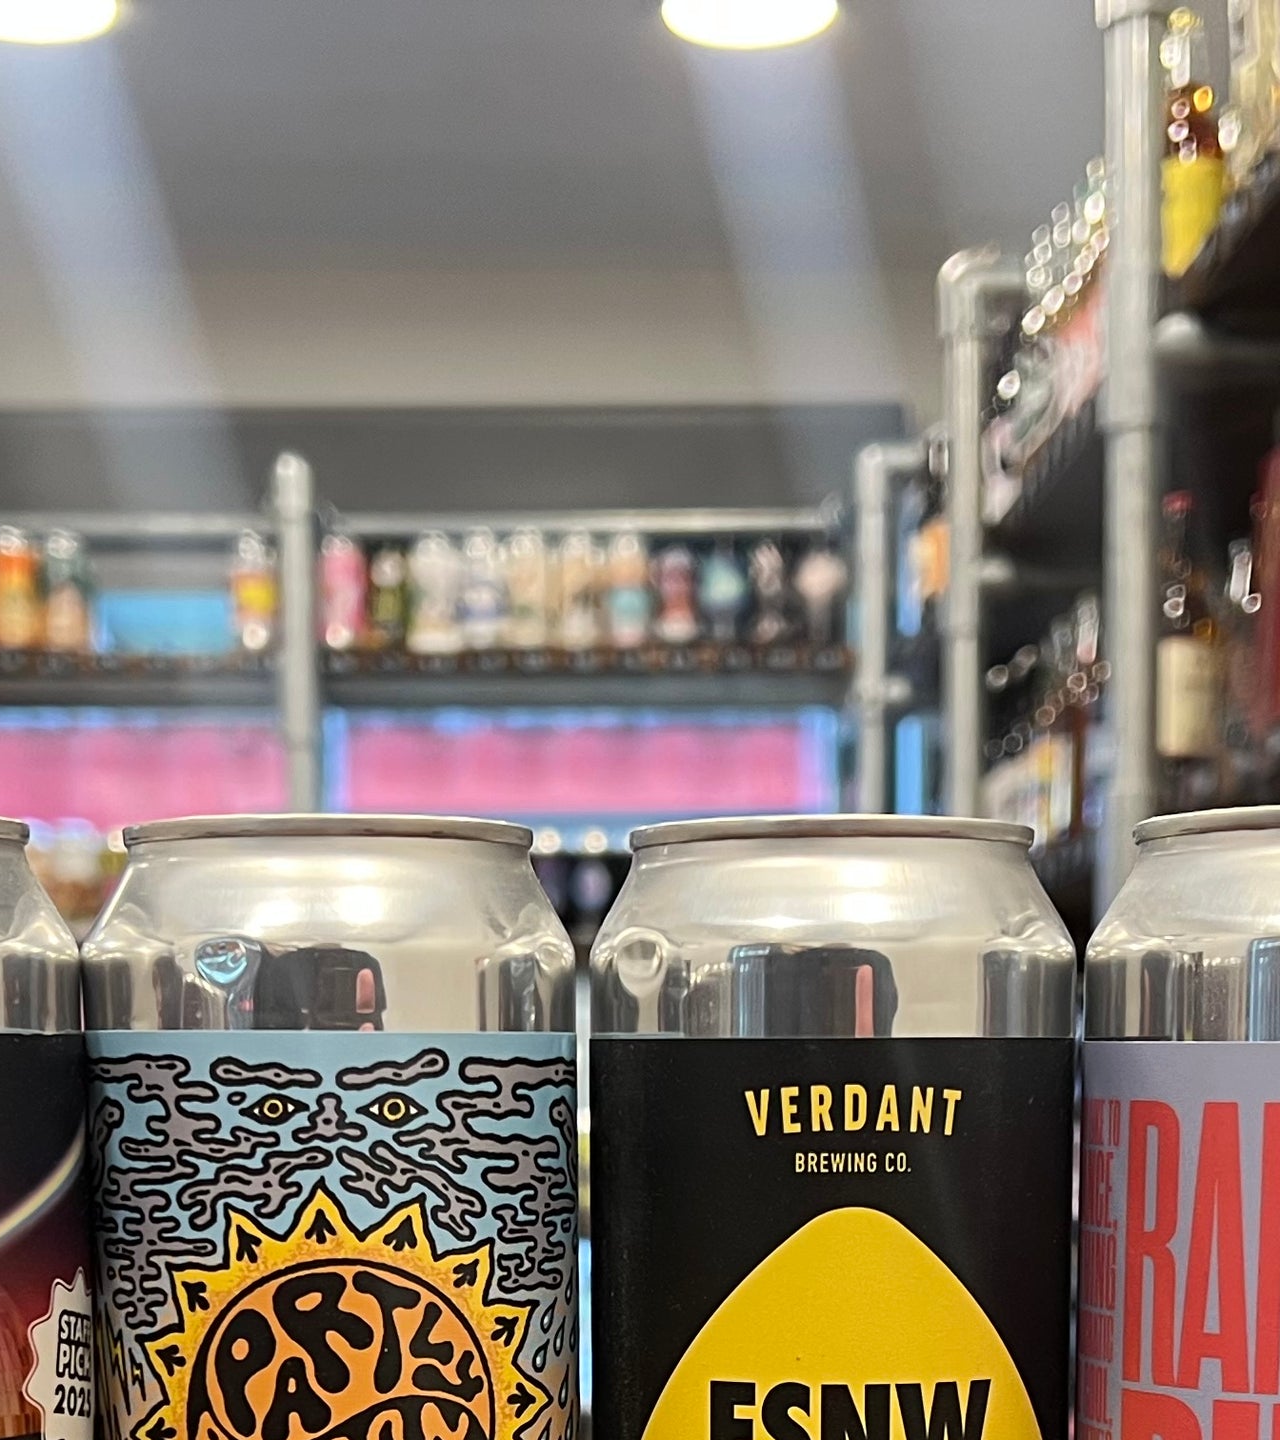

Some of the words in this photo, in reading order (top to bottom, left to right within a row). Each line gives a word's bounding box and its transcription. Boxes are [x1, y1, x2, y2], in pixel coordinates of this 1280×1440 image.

[745, 1084, 963, 1137] VERDANT
[795, 1152, 879, 1174] BREWING
[886, 1151, 912, 1173] CO.
